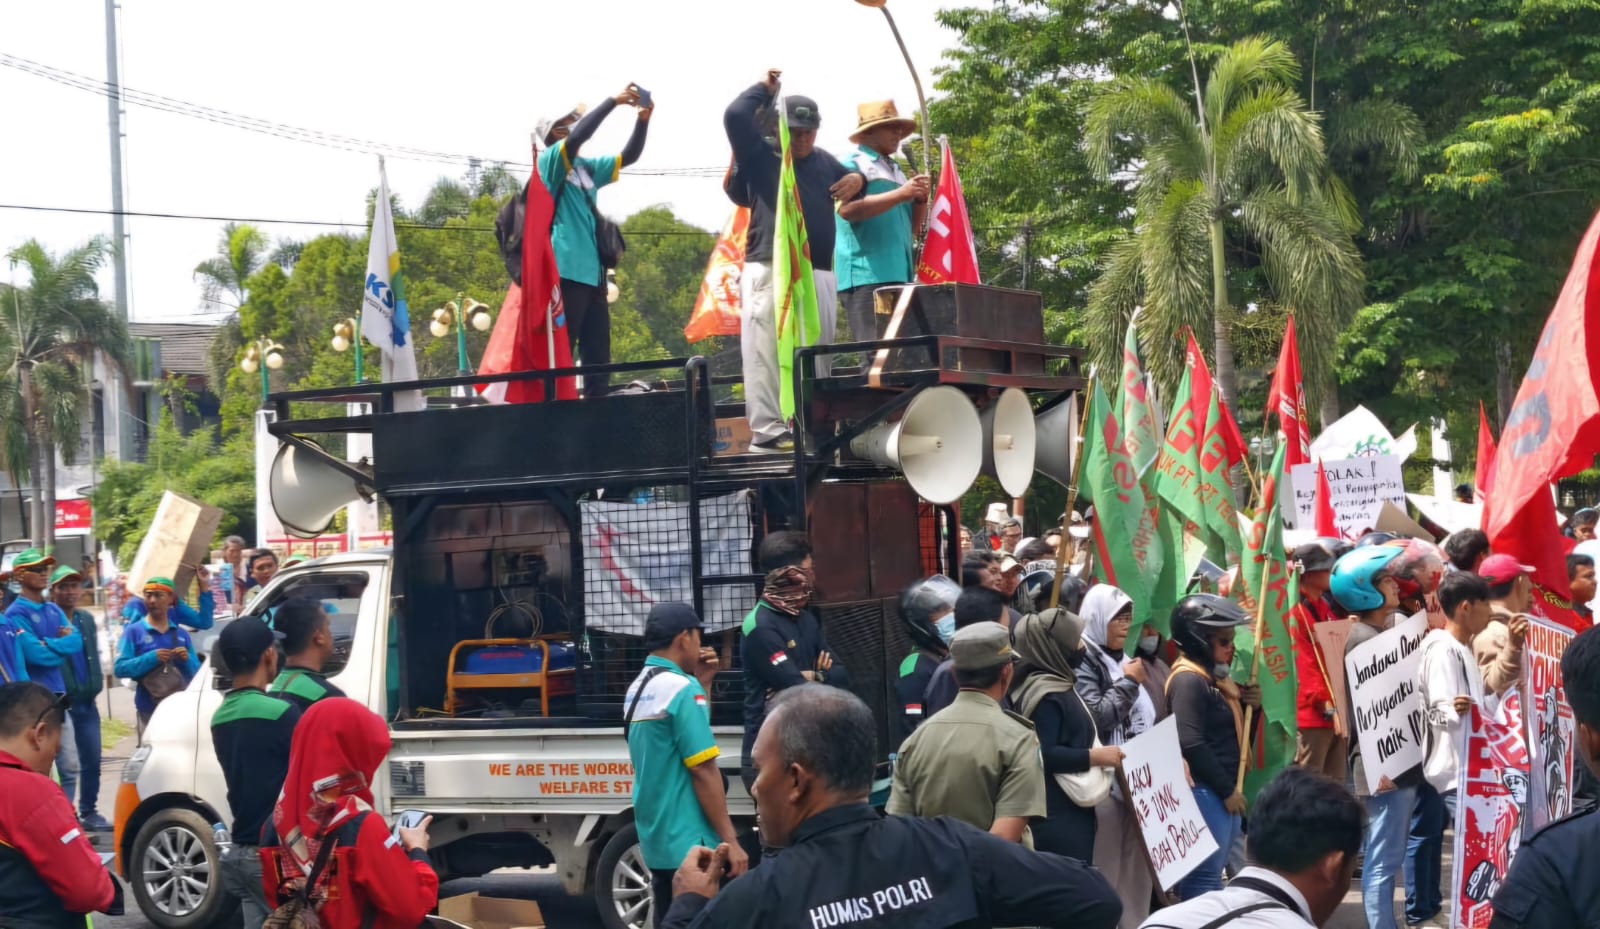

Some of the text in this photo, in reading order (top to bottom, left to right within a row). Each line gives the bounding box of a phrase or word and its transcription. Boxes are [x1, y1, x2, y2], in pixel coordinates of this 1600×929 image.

[1263, 646, 1289, 684] ASIA
[488, 763, 512, 777] WE
[515, 763, 545, 777] ARE
[549, 763, 580, 776] THE
[539, 781, 609, 795] WELFARE
[809, 876, 933, 929] HUMAS POLRI
